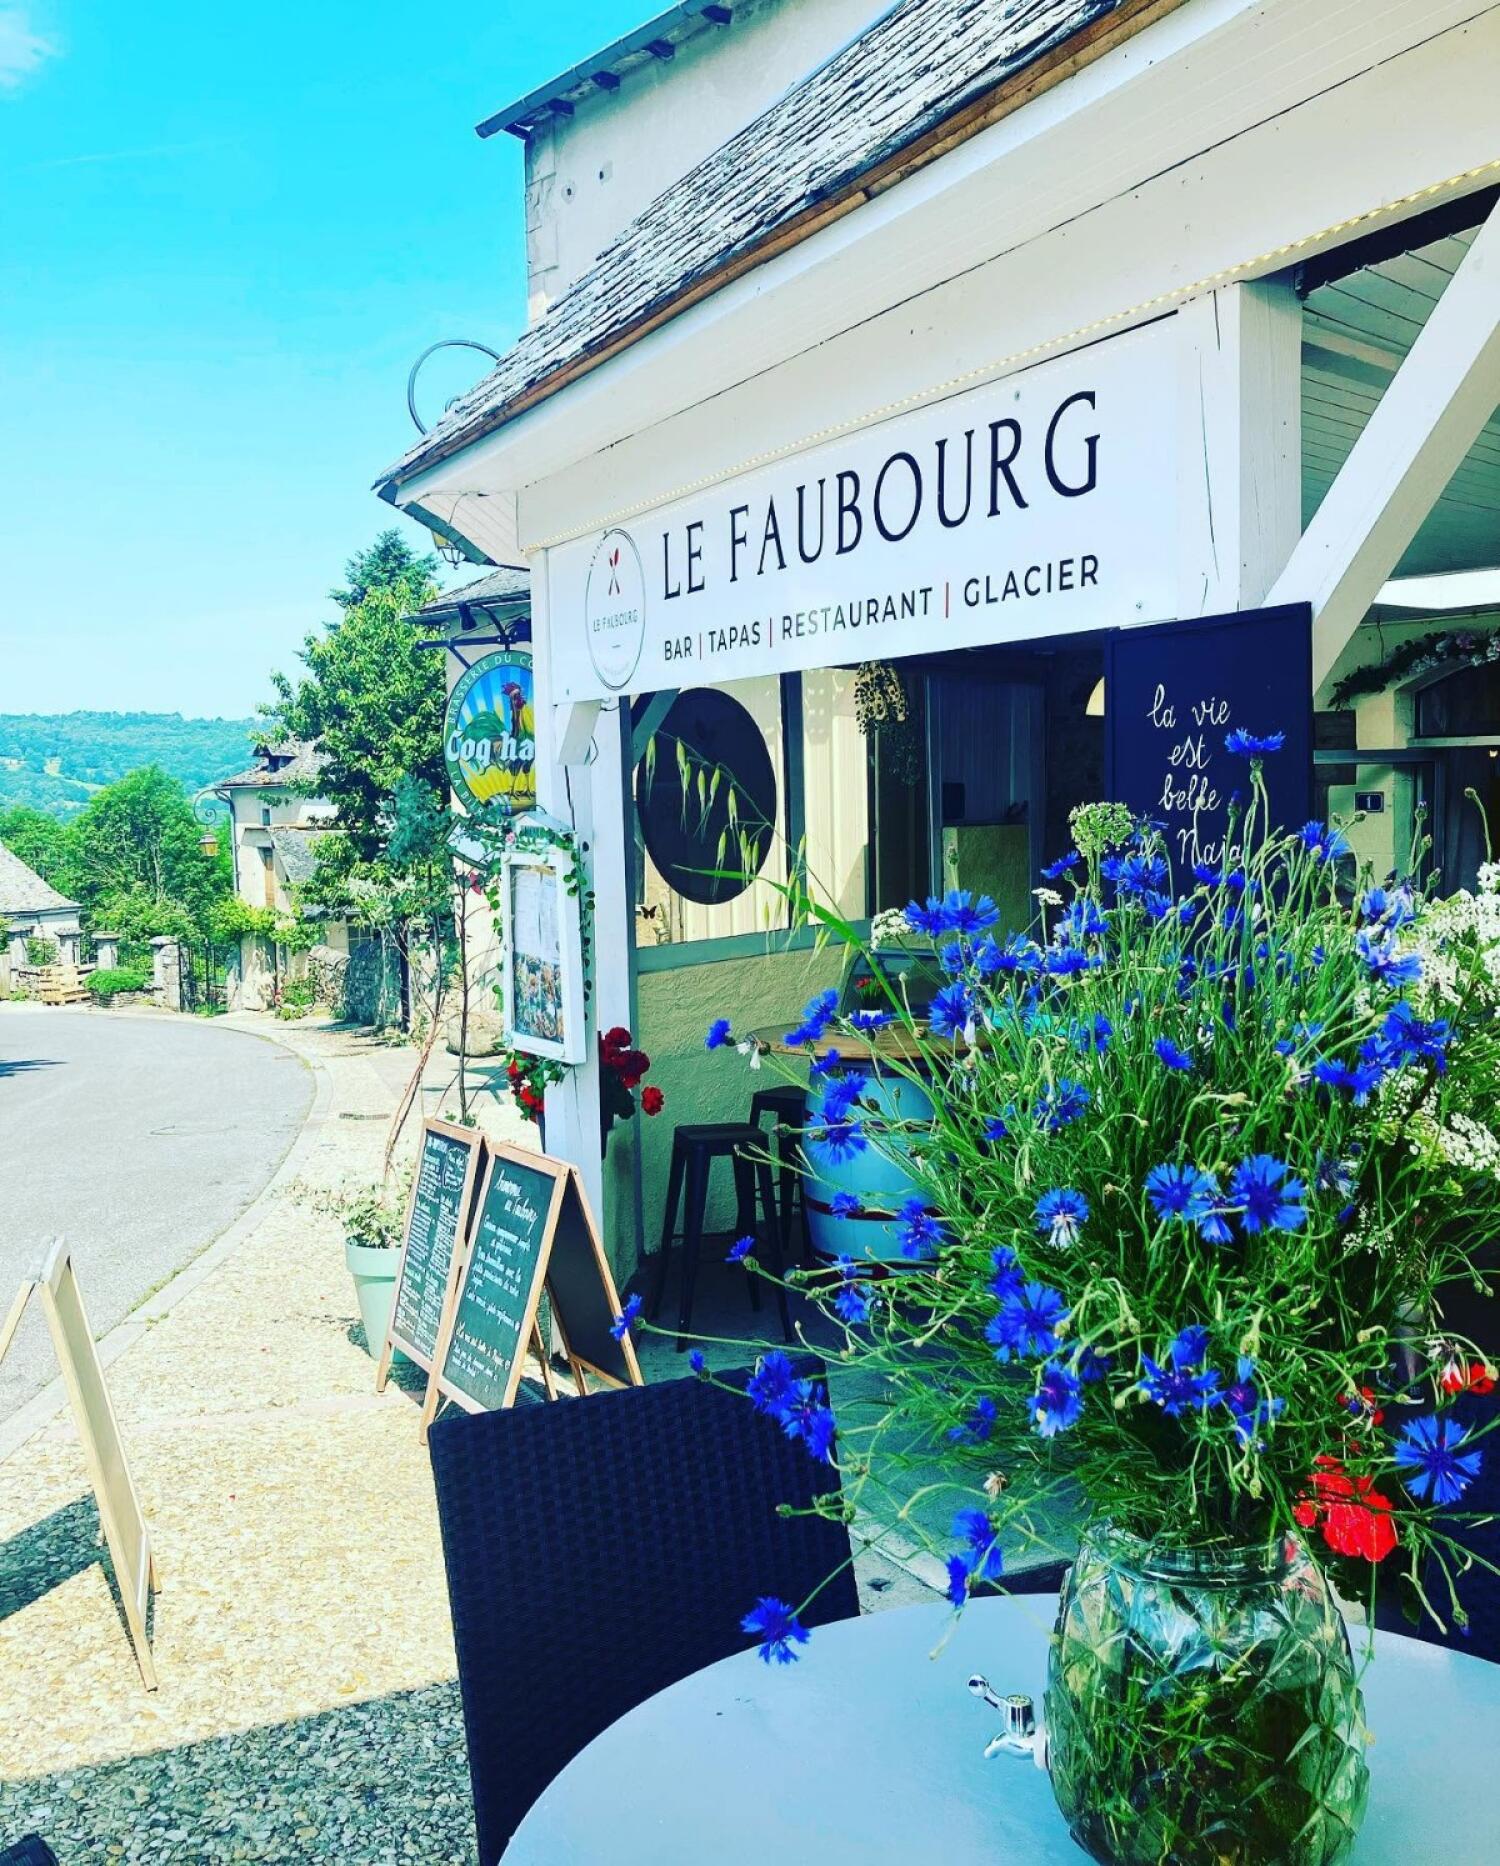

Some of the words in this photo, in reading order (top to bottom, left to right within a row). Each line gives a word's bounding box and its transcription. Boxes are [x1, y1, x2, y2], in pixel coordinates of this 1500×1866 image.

[662, 520, 706, 601] LE
[729, 390, 1101, 583] FAUBOURG
[664, 635, 693, 661] BAR
[708, 620, 761, 653] TAPAS
[782, 586, 933, 640] RESTAURANT
[963, 554, 1099, 607] GLACIER
[494, 653, 512, 665] DU
[1146, 683, 1176, 728] la
[1191, 696, 1231, 726] vie
[1166, 733, 1213, 769] est
[1157, 773, 1222, 811] belle
